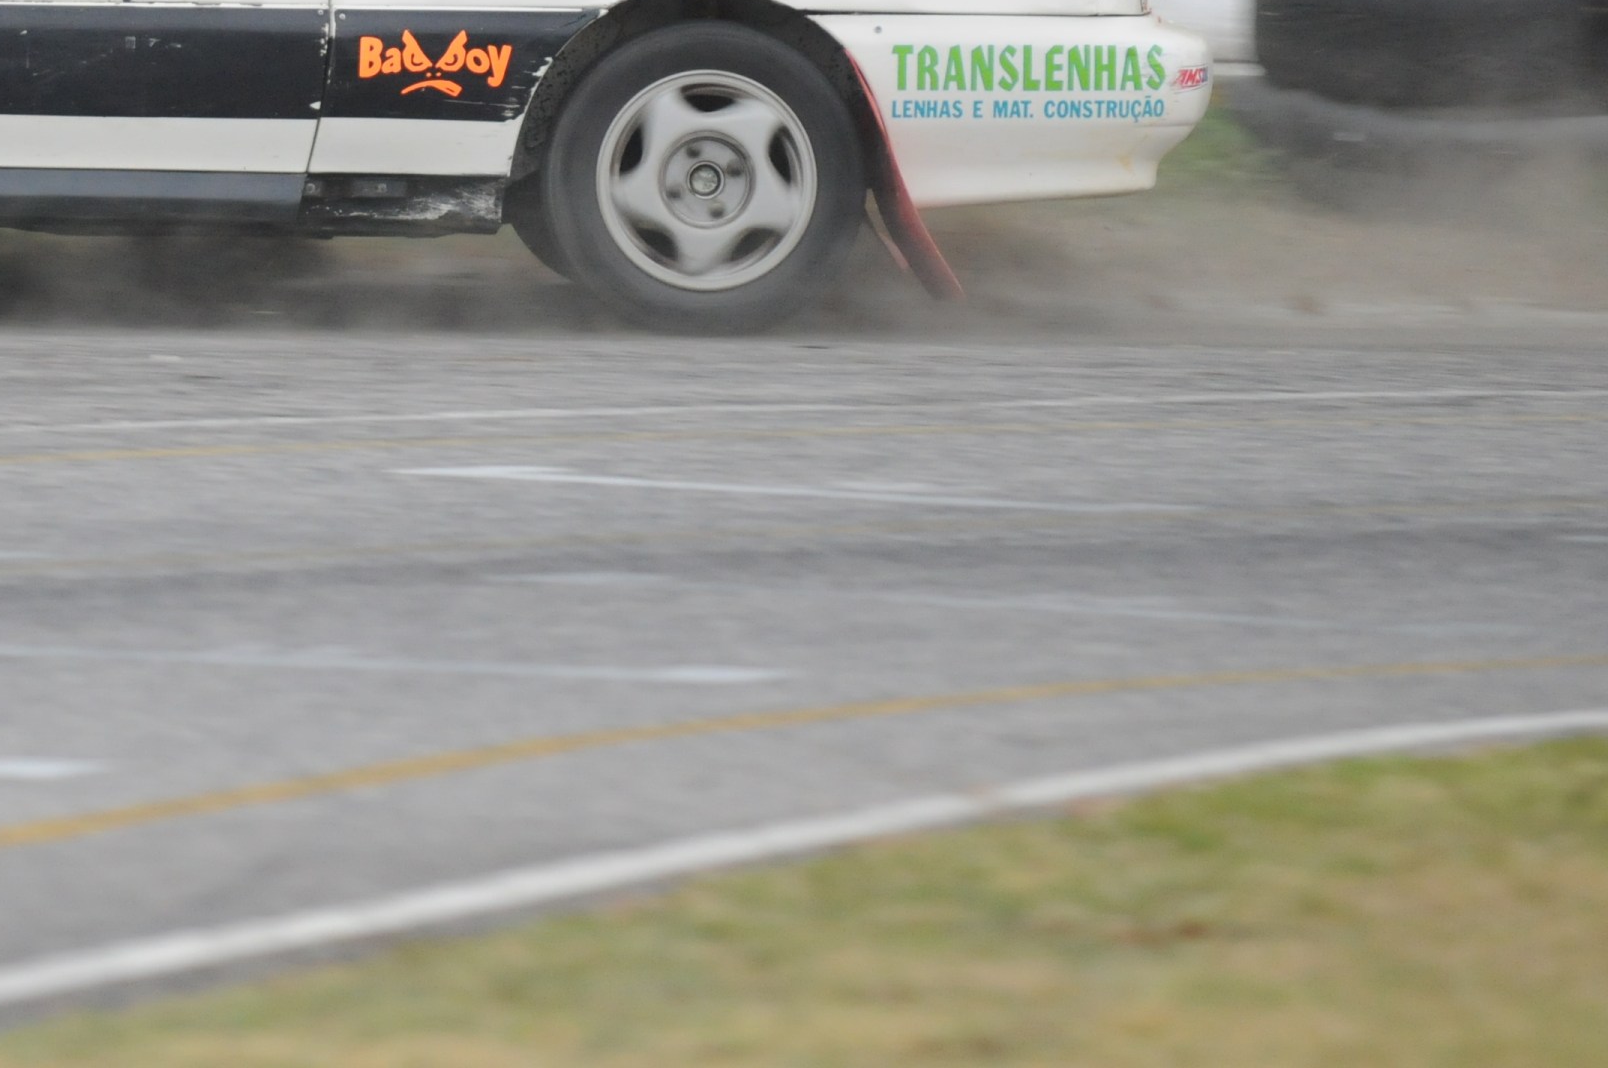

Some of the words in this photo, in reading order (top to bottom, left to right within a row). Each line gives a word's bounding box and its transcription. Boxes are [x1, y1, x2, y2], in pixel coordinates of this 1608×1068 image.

[892, 44, 1167, 91] TRANSLENHAS
[892, 100, 964, 119] LENHAS
[972, 100, 984, 118] E
[993, 100, 1034, 119] MAT.
[1044, 95, 1166, 123] CONSTRUÇÃO
